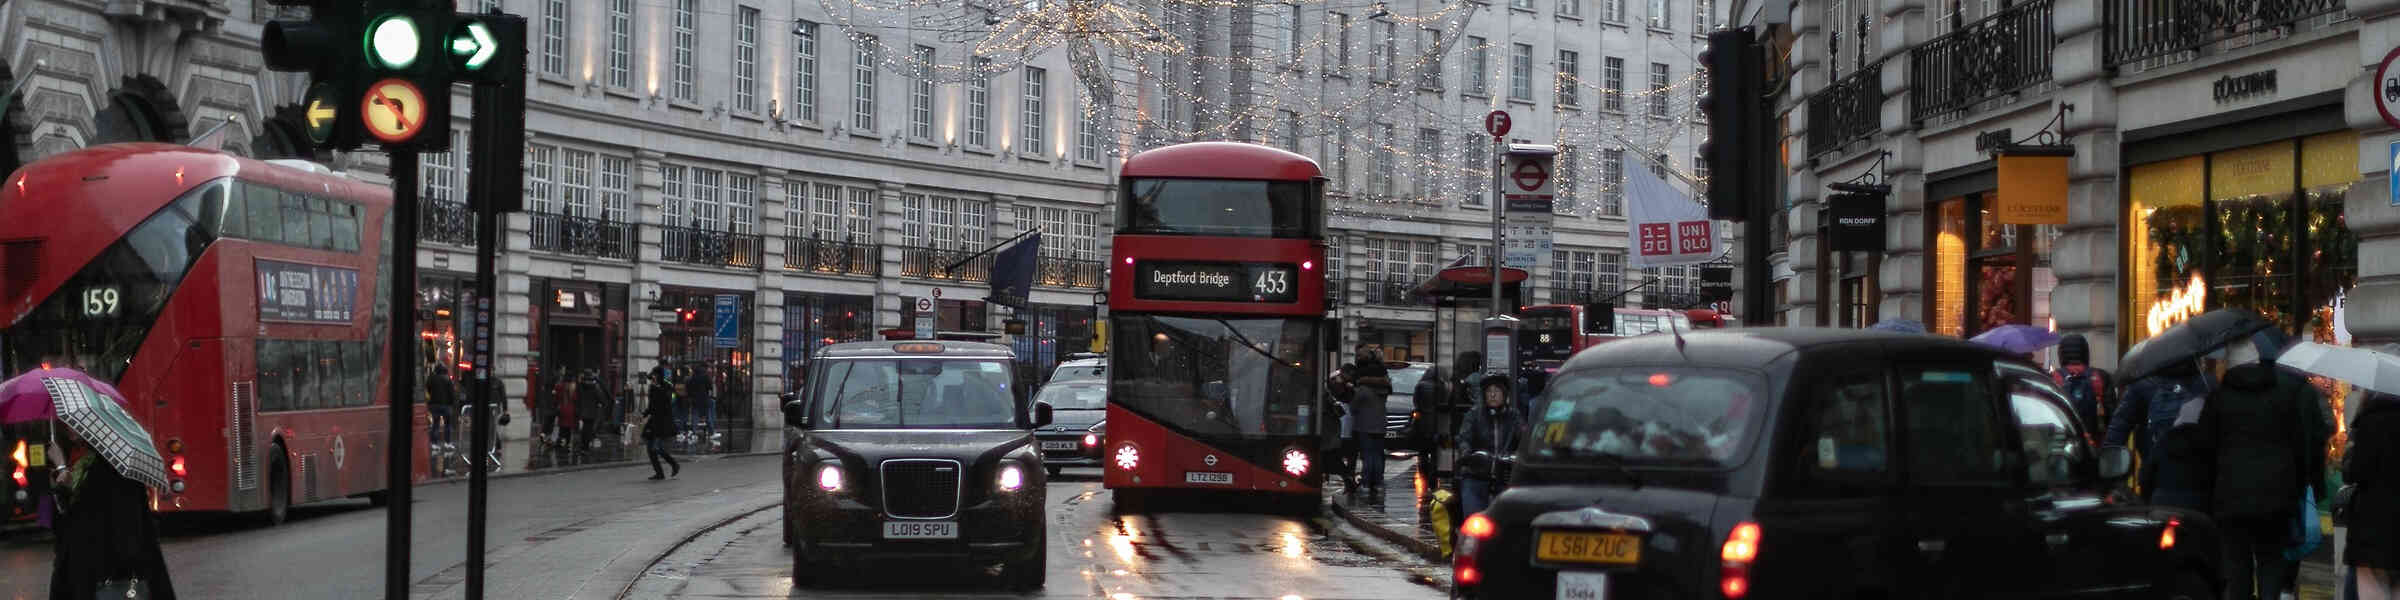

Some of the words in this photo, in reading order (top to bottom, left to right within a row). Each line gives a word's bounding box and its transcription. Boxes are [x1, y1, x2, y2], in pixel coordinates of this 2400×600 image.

[1492, 114, 1505, 132] F
[1681, 224, 1706, 237] UNI
[1682, 237, 1708, 252] QLO
[1154, 270, 1196, 287] Deptford
[1199, 271, 1230, 287] Bridge
[1255, 270, 1287, 294] 453
[83, 288, 119, 315] 159
[924, 523, 950, 536] SPU
